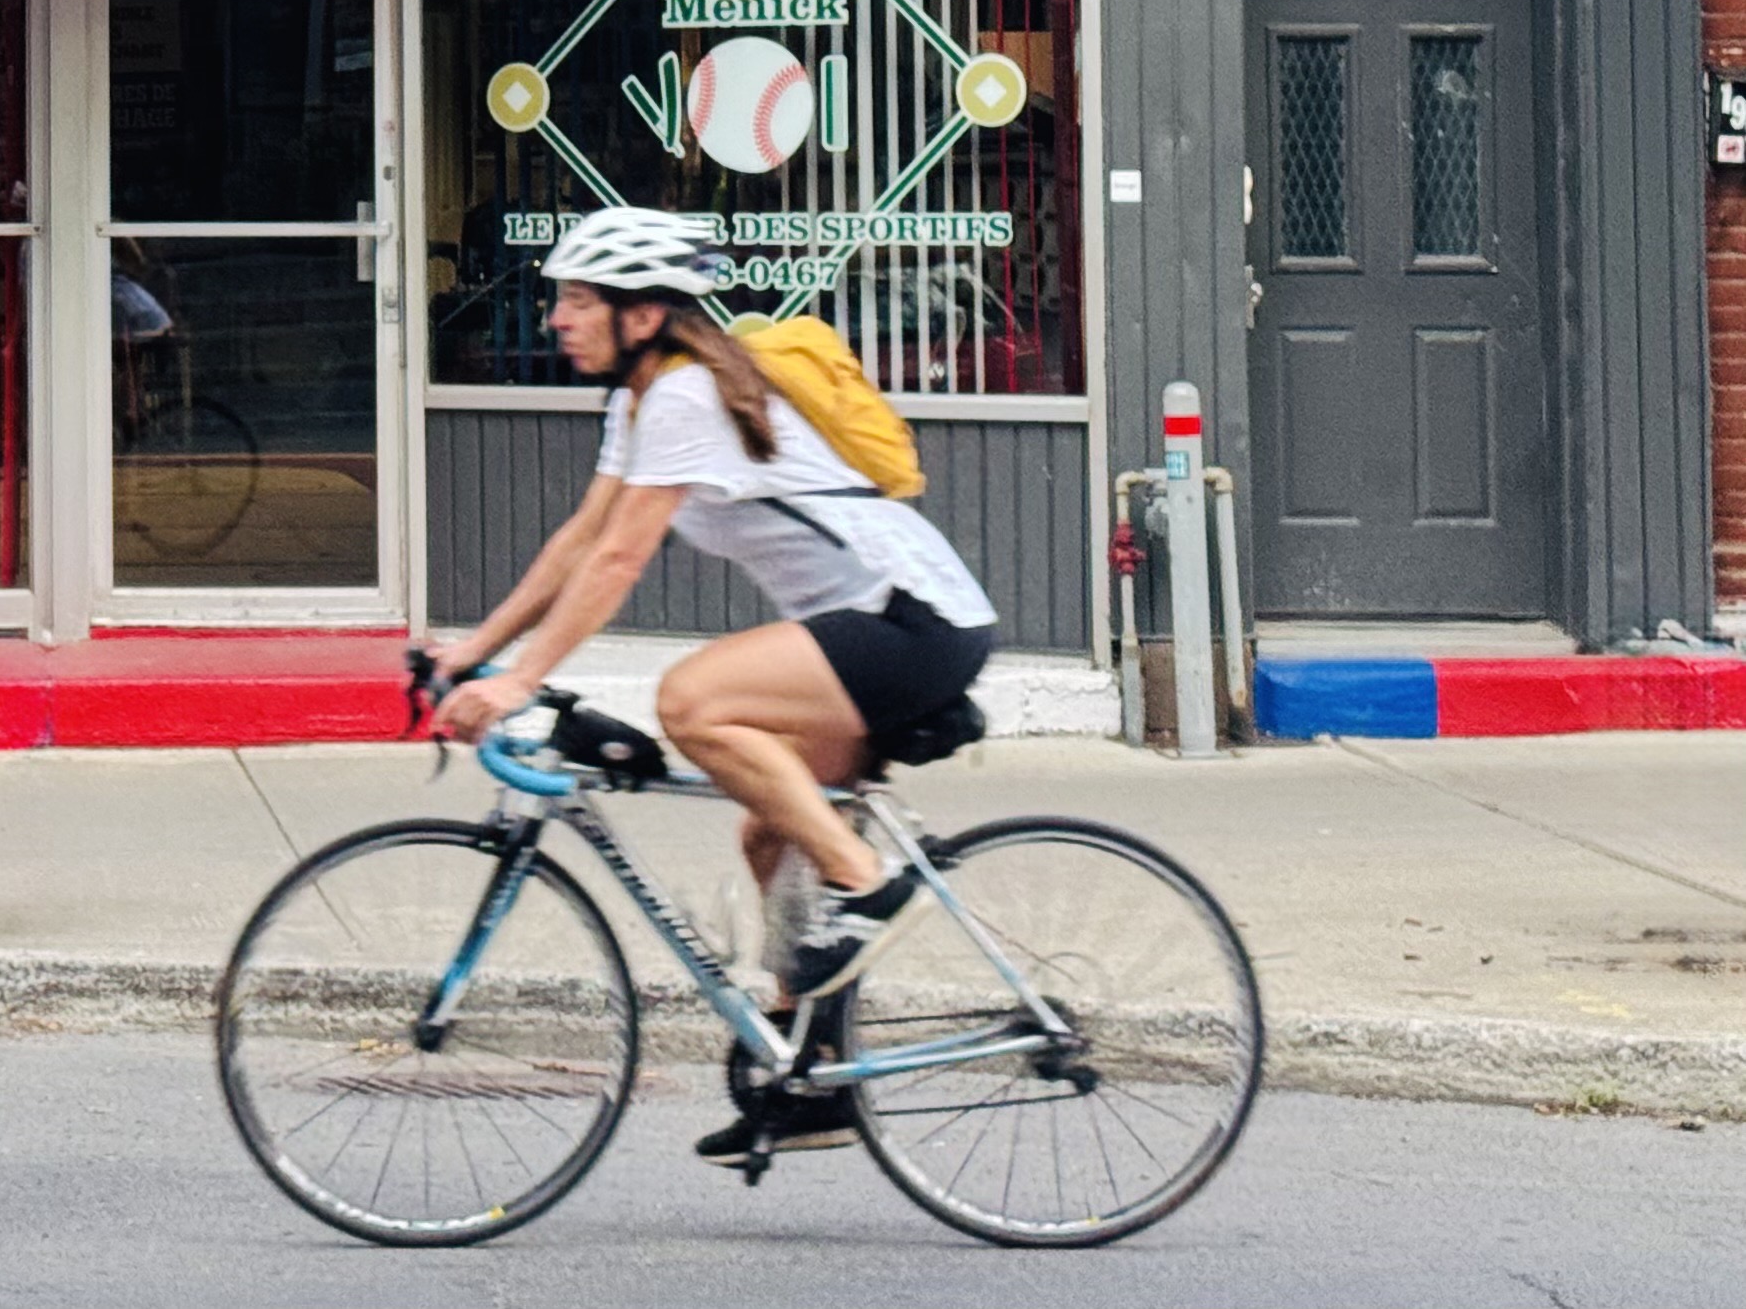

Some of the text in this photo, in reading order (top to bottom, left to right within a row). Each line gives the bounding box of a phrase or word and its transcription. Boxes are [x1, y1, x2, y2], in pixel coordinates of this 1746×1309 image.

[504, 213, 554, 245] LE
[732, 212, 811, 246] DES
[816, 212, 1013, 246] SPORTIFS
[714, 255, 841, 290] 8-0467
